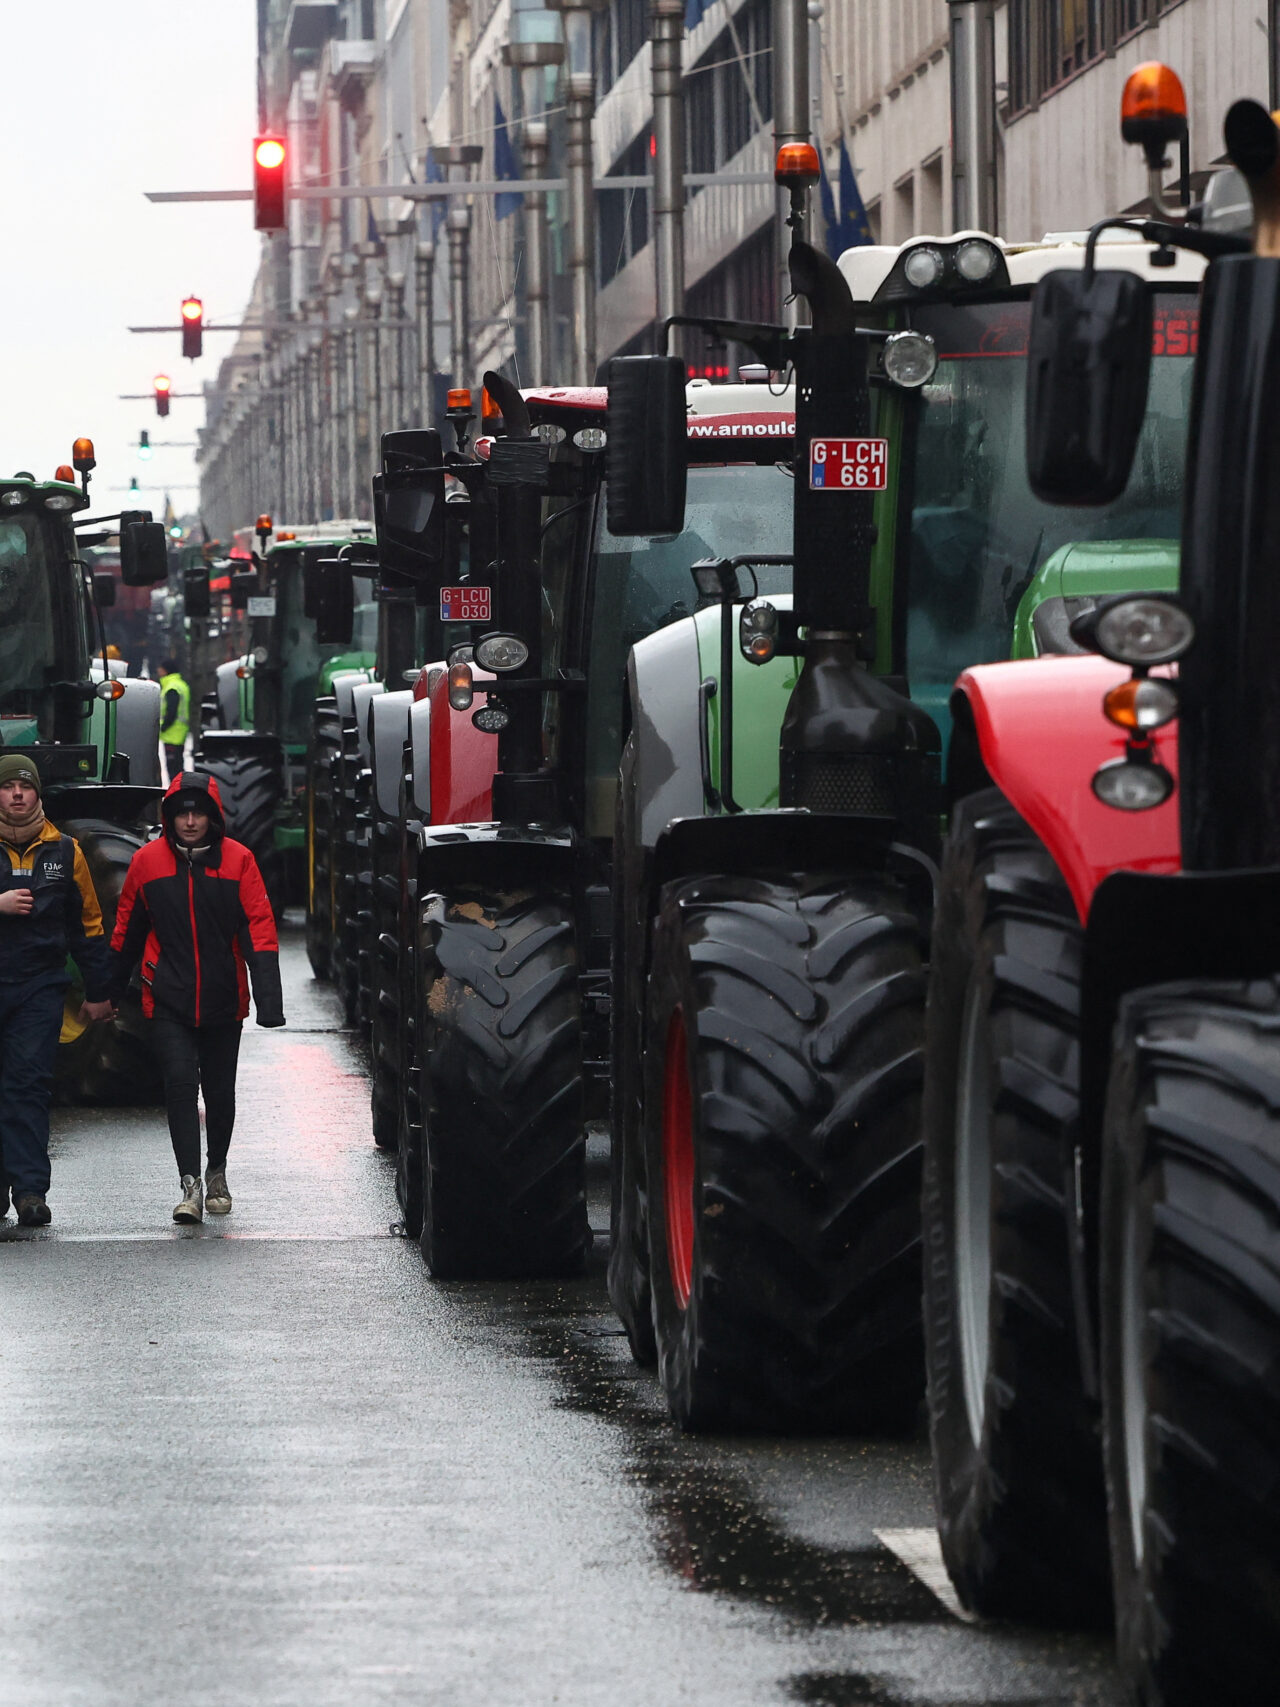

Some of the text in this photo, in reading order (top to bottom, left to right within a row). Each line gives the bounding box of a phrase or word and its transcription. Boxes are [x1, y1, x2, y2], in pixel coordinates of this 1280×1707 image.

[813, 442, 885, 464] G-LCH
[840, 464, 881, 486] 661
[442, 589, 488, 603] G-LCU
[461, 605, 488, 618] 030
